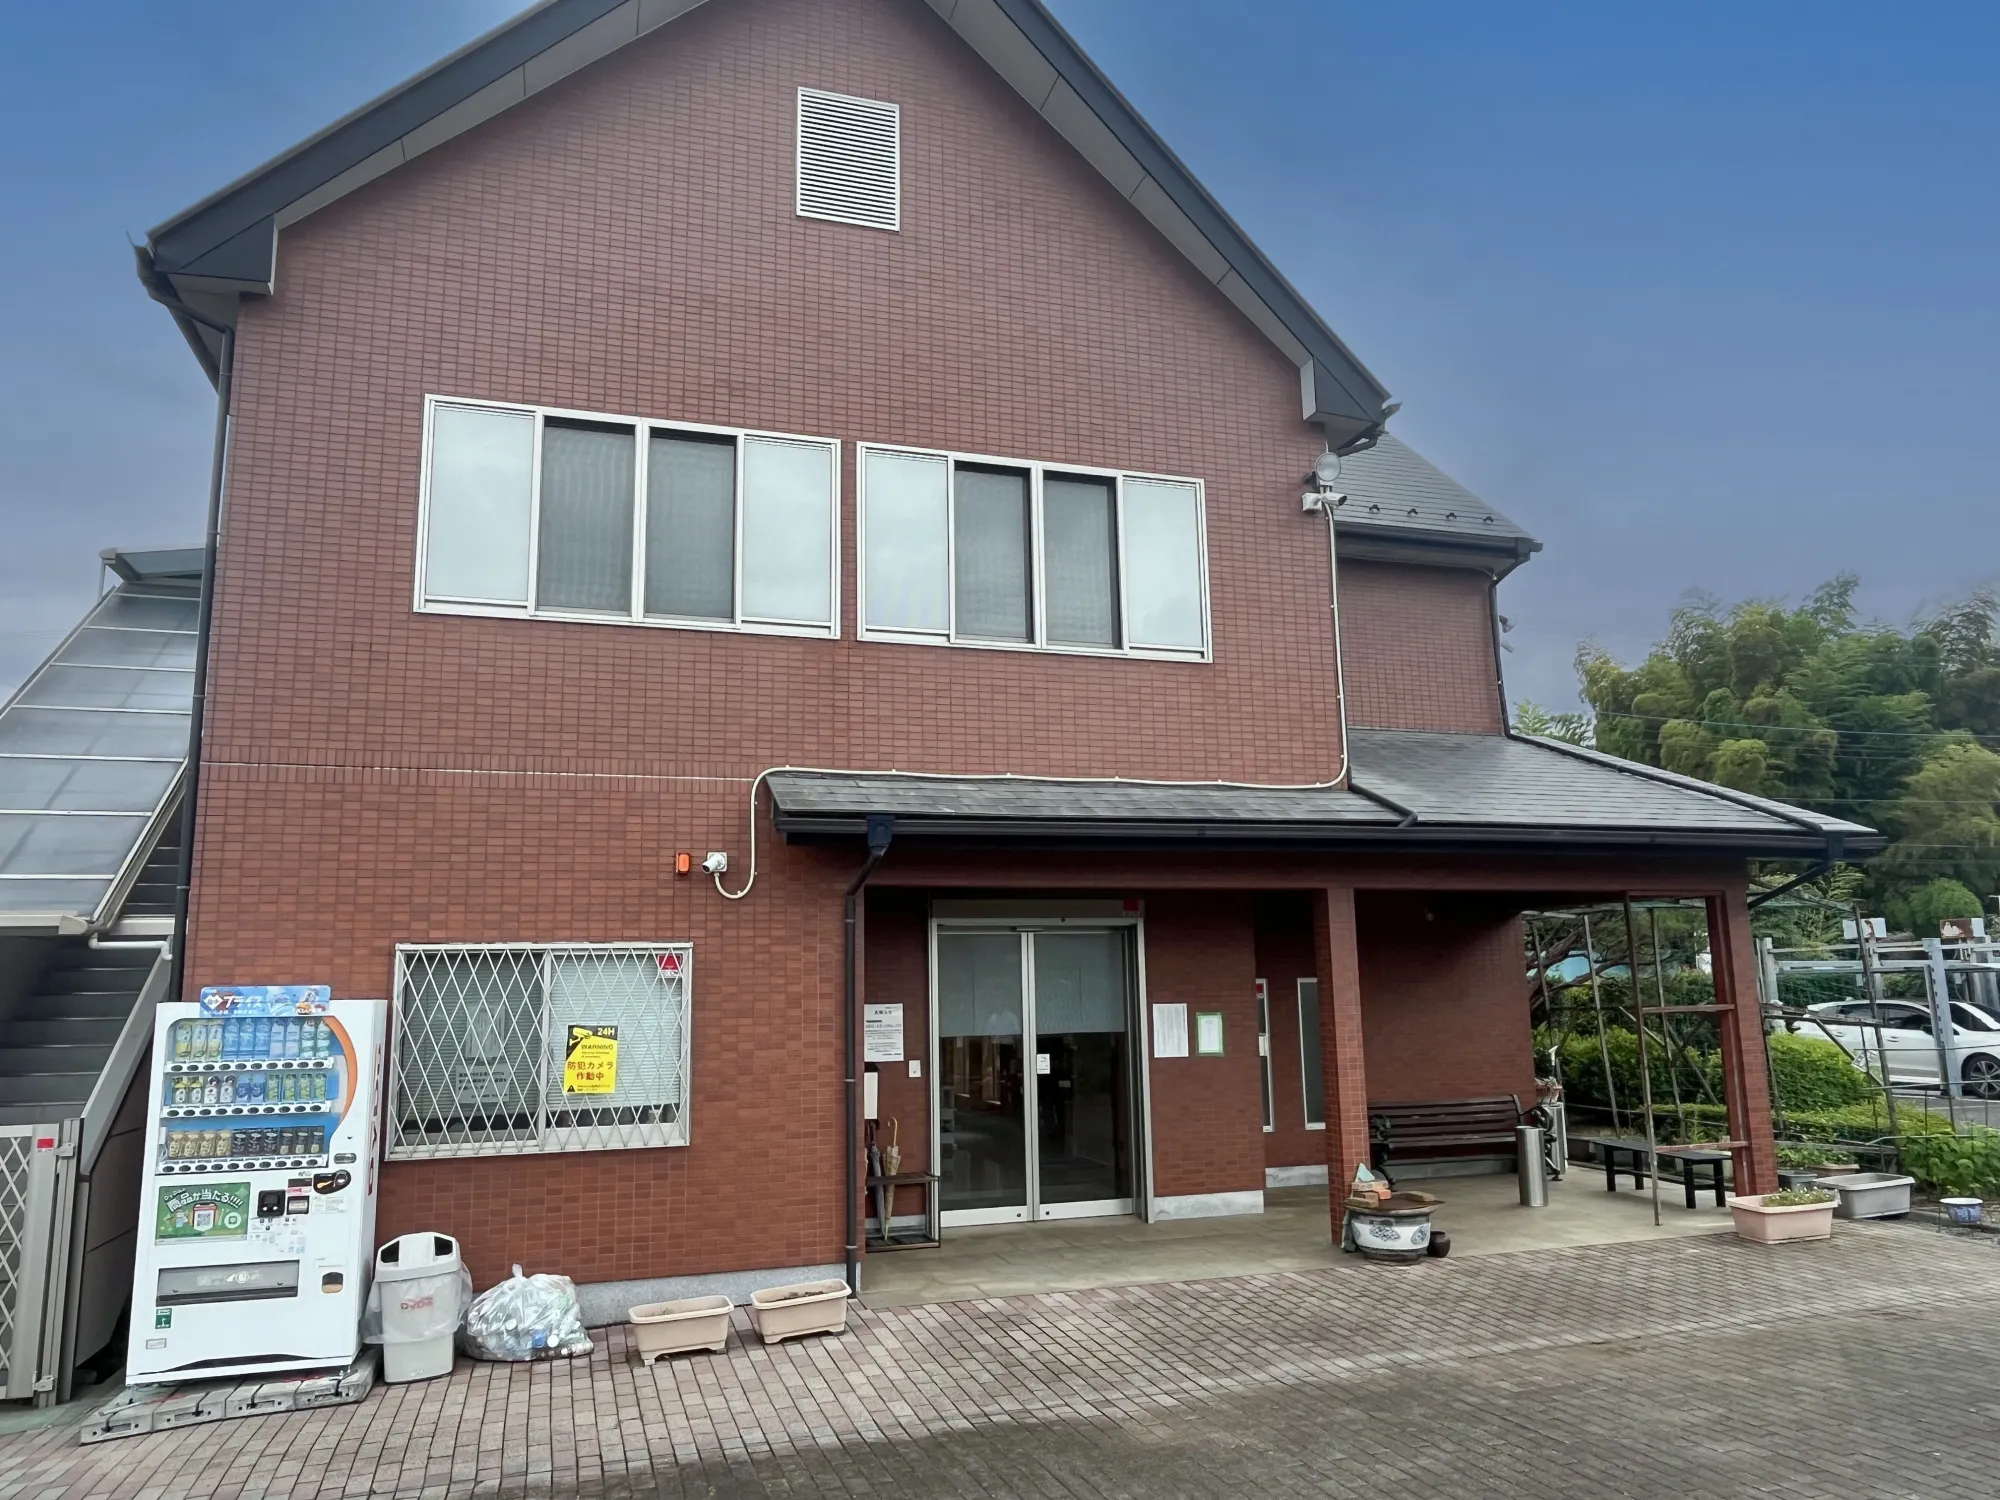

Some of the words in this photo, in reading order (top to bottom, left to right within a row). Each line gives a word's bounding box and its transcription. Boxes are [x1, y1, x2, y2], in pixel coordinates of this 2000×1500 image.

[597, 1027, 615, 1036] 24H
[567, 1061, 614, 1071] 防犯カメラ
[576, 1071, 604, 1081] 作動中
